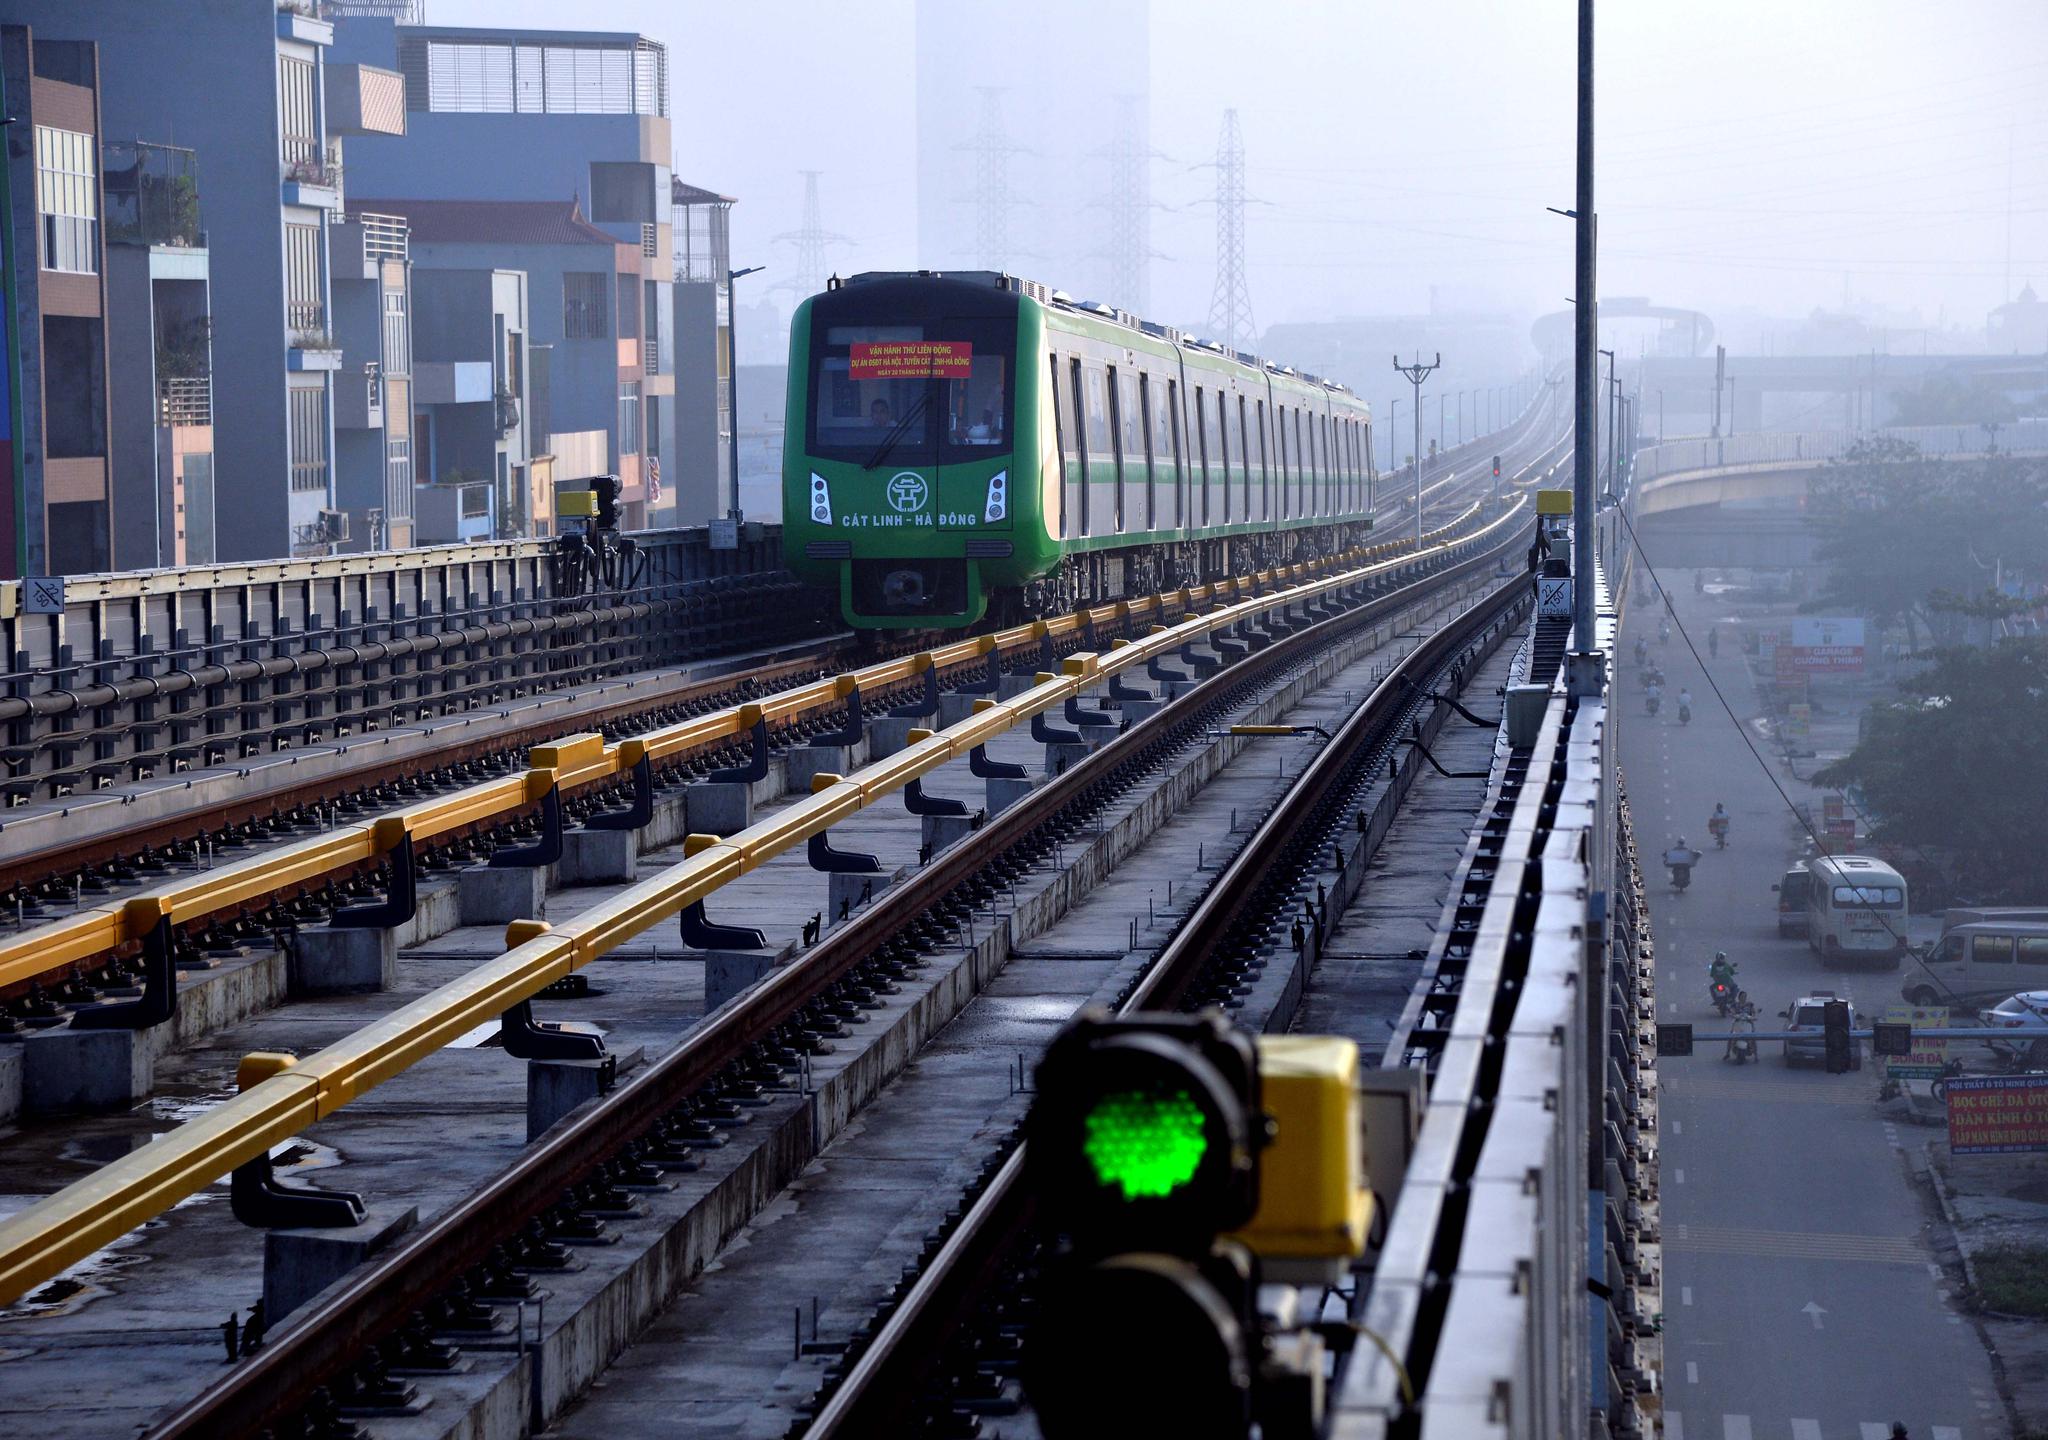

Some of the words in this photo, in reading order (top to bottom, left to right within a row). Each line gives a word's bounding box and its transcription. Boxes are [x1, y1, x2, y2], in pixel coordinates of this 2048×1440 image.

[842, 512, 868, 527] CÁT
[873, 514, 903, 527] LINH
[915, 512, 933, 526] HÀ
[938, 511, 976, 526] ĐÔNG
[46, 583, 59, 598] 22
[1541, 584, 1554, 598] 22
[32, 590, 50, 608] 150
[1550, 590, 1565, 608] 150
[2005, 1080, 2025, 1088] MINH
